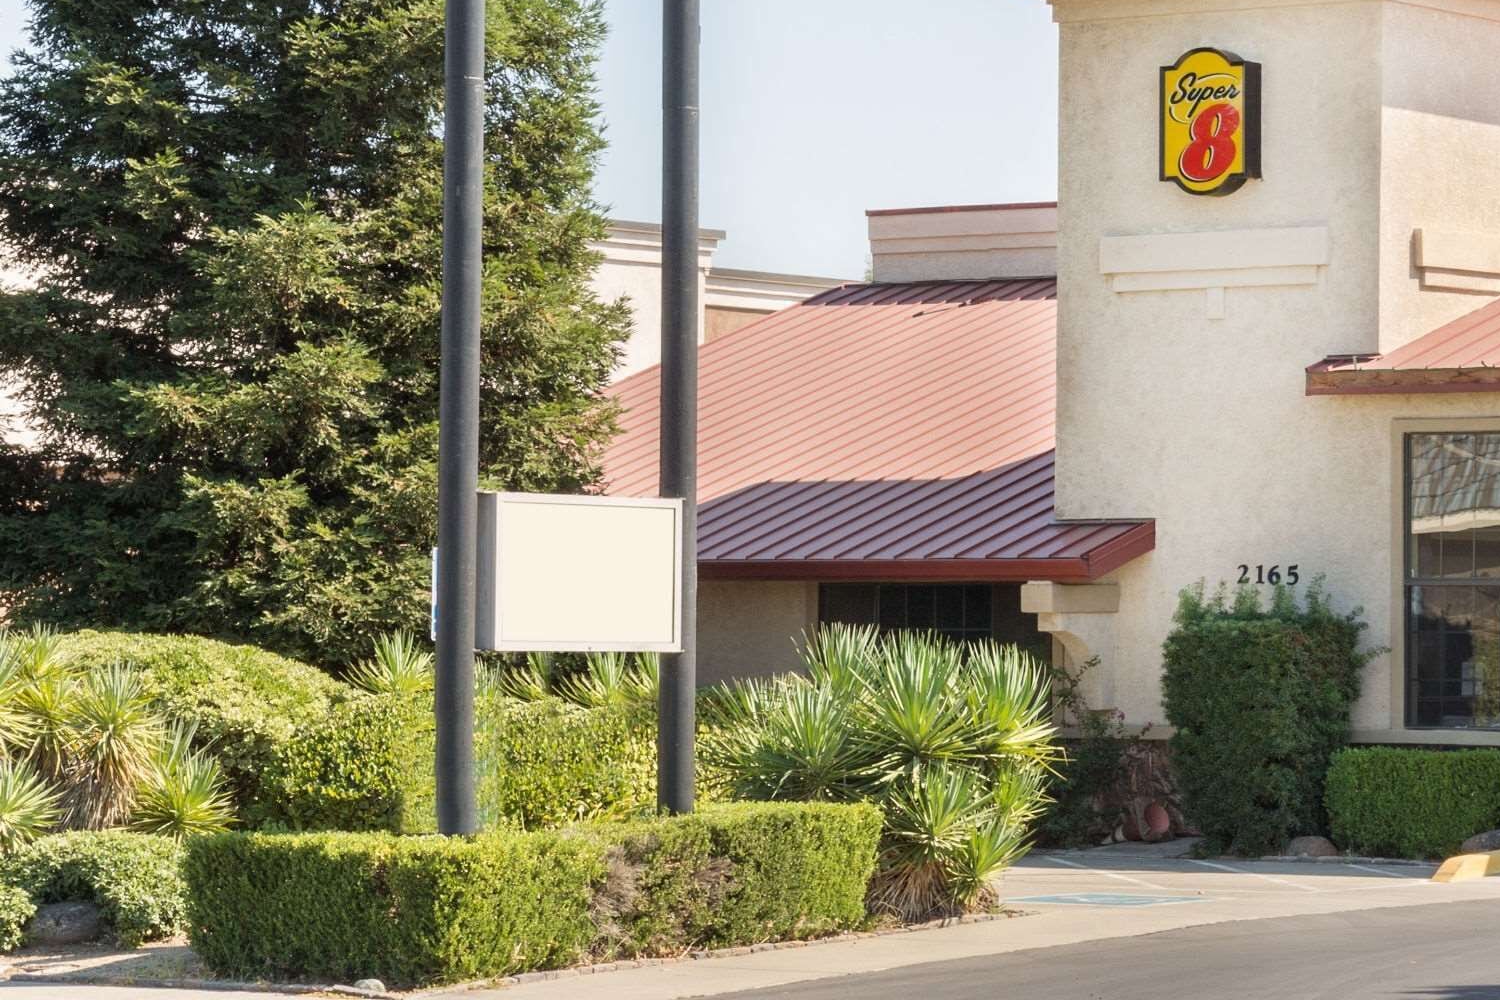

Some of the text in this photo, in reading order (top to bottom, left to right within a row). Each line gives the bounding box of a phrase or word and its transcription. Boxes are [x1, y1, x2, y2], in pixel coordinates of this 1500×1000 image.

[1170, 72, 1240, 118] Super
[1179, 103, 1240, 182] 8
[1236, 564, 1300, 586] 2165
